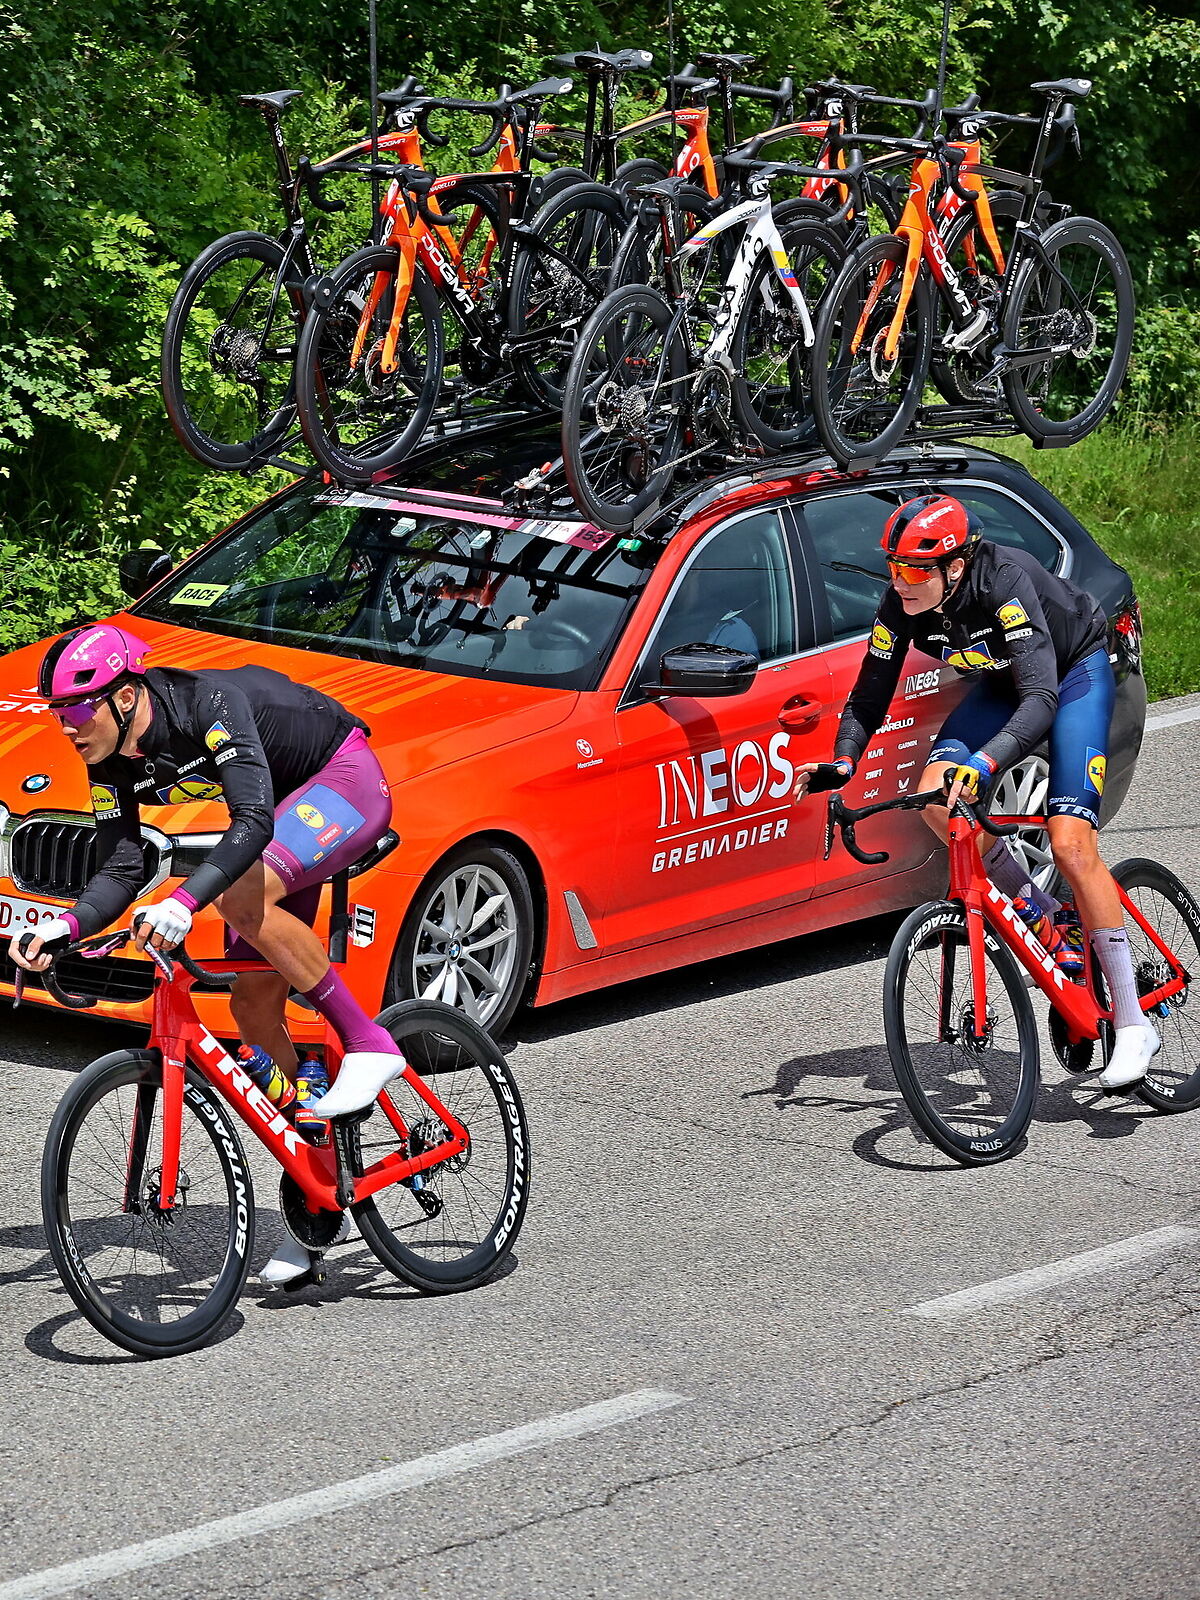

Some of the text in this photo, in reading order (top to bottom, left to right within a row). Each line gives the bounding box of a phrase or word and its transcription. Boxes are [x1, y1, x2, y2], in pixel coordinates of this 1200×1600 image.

[526, 120, 536, 147] INEOS
[534, 128, 551, 136] RELLO
[1044, 111, 1055, 137] INEOS
[377, 138, 407, 149] DOGMA
[429, 180, 457, 193] NARELLO
[736, 206, 762, 221] DOGMA
[420, 232, 475, 315] DOGMA
[927, 229, 972, 317] DOGMA
[1006, 252, 1021, 296] GRENADIER
[561, 316, 583, 328] MOST
[1051, 344, 1073, 353] MOST
[536, 520, 571, 533] OYOTA
[575, 527, 609, 544] 153
[179, 588, 220, 601] RACE
[69, 630, 108, 661] TREK
[904, 668, 941, 694] INEOS
[177, 756, 207, 775] SRAM
[654, 731, 795, 829] INEOS
[303, 809, 318, 823] LIDL
[1056, 803, 1099, 827] TRE
[319, 826, 340, 844] TREK
[651, 818, 789, 873] GRENADIER
[355, 907, 375, 942] 111
[1177, 892, 1200, 932] EOLUS
[907, 912, 1000, 961] BTRAGER
[986, 877, 1071, 991] TREK
[198, 1023, 308, 1157] TREK
[489, 1063, 524, 1252] BONTRAGER
[970, 1138, 1003, 1153] AEOLUS
[63, 1224, 91, 1287] AEOLUS
